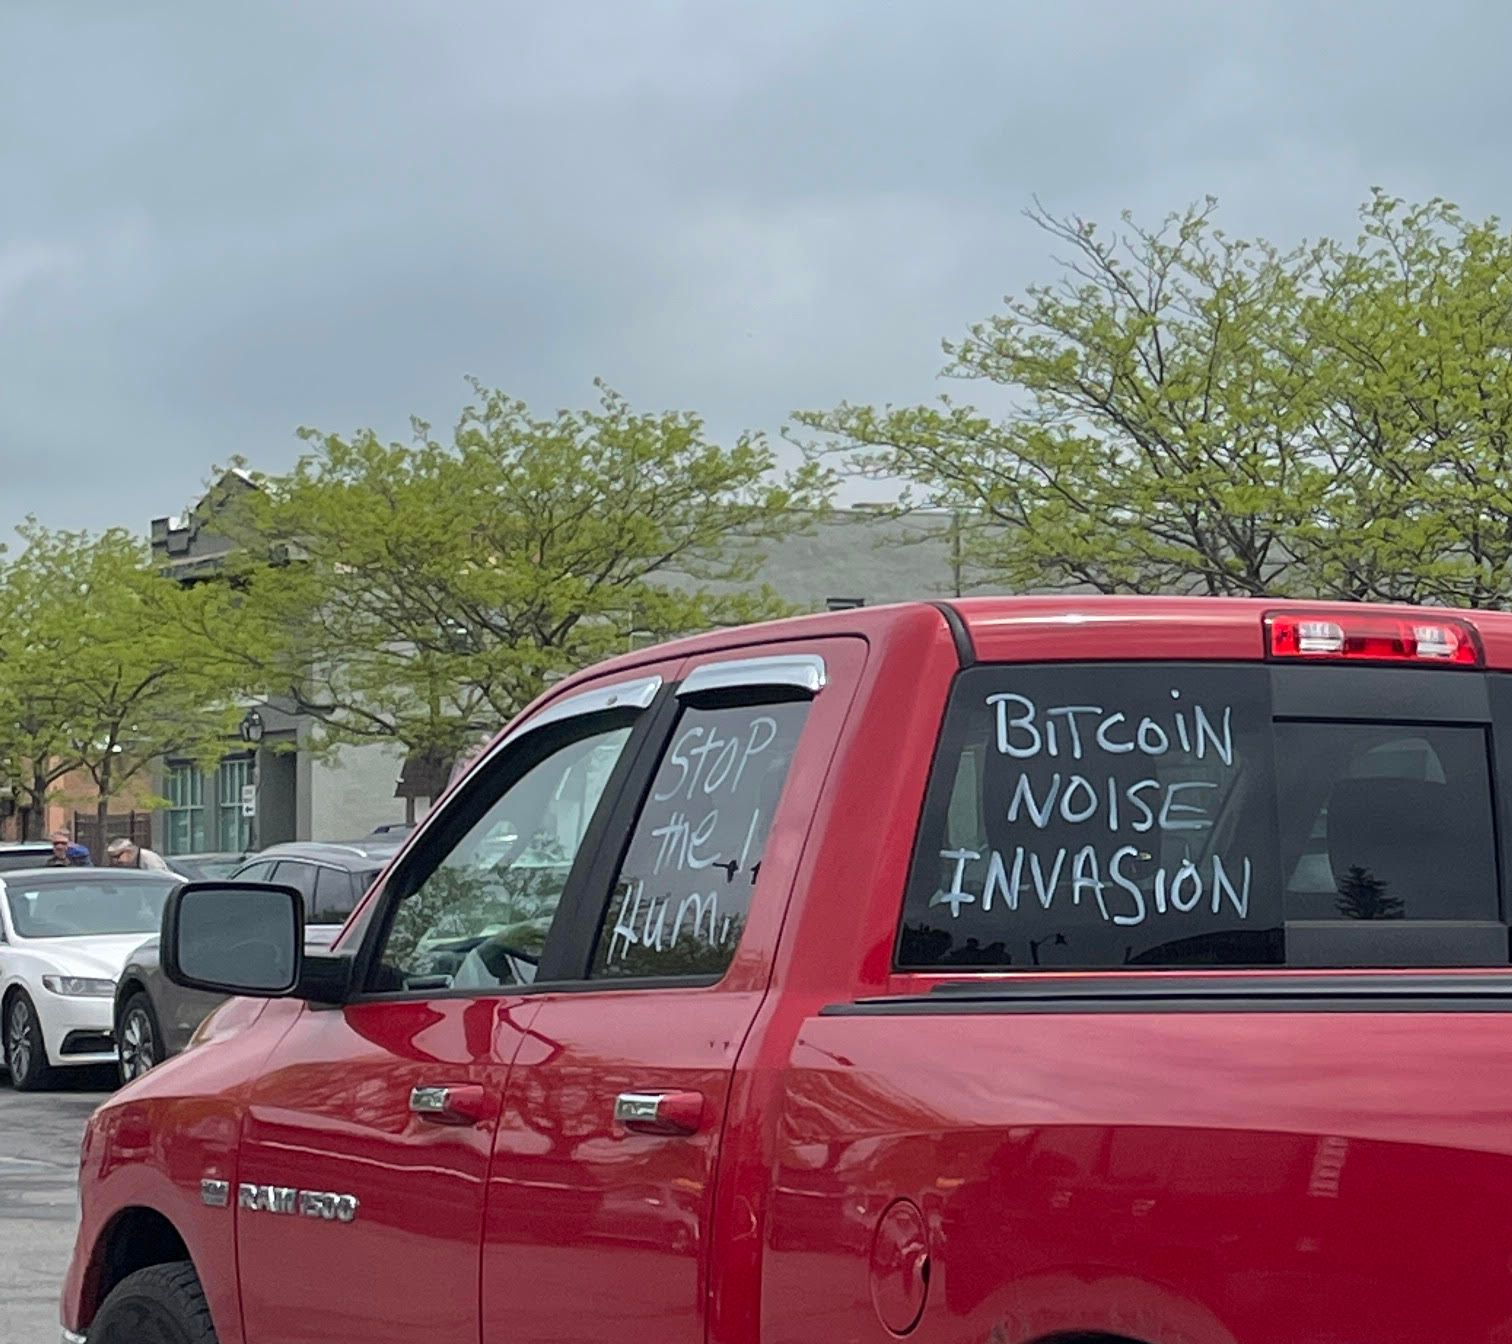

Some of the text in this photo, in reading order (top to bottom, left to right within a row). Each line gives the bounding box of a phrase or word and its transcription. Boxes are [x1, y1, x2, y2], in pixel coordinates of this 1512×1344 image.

[1007, 773, 1217, 832] NOISE
[940, 845, 1250, 925] INVASION
[239, 1183, 297, 1215] RAM
